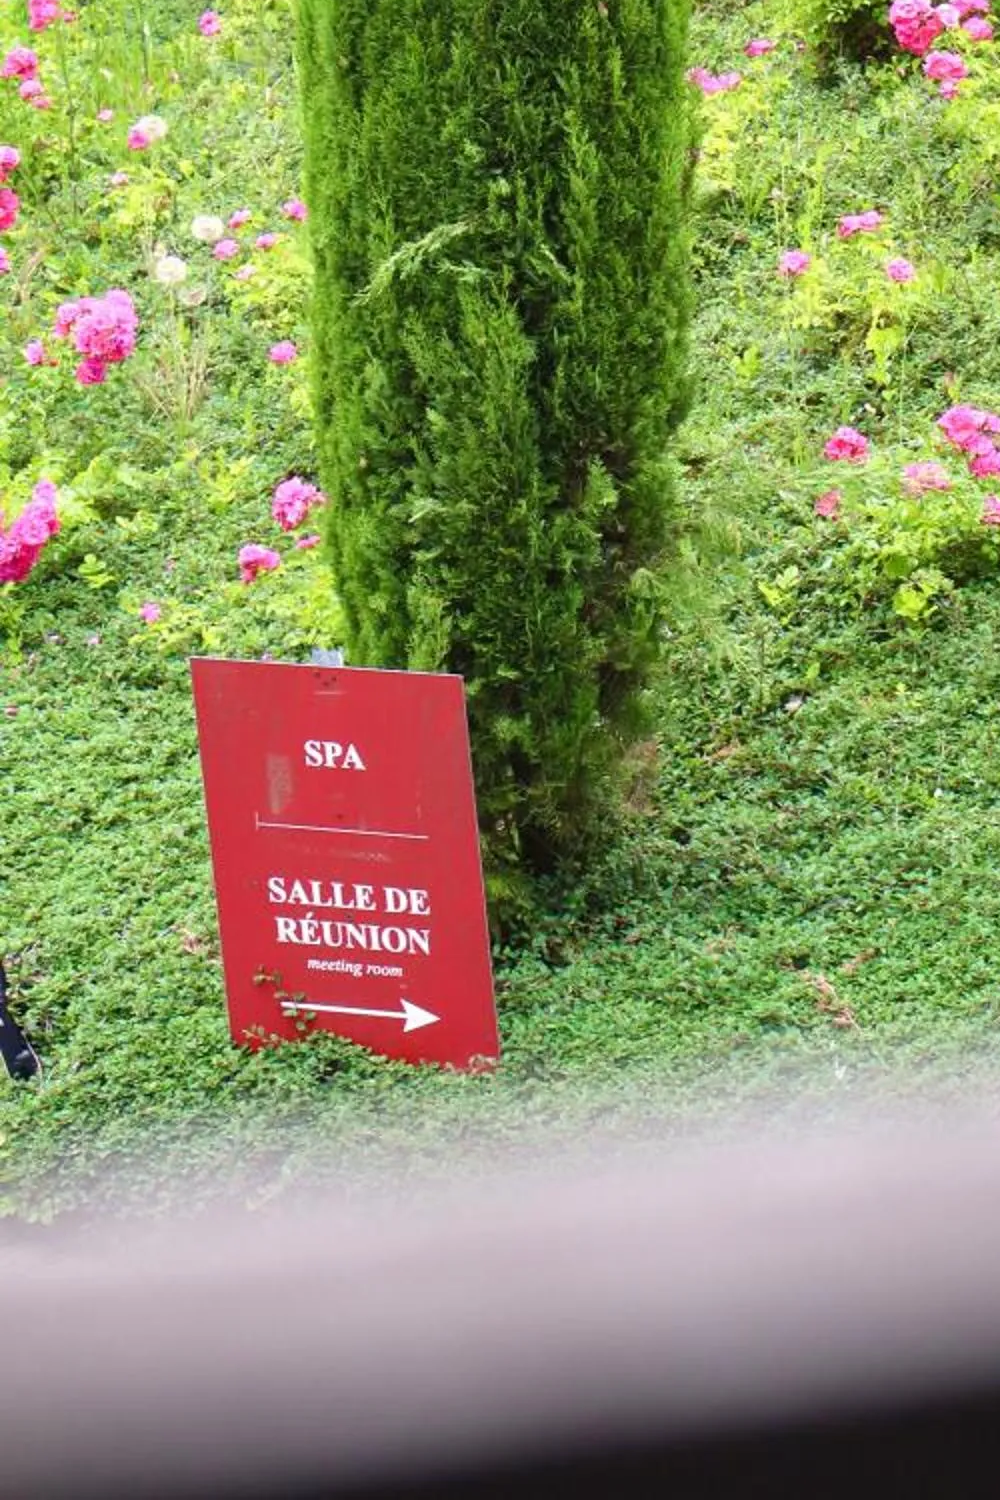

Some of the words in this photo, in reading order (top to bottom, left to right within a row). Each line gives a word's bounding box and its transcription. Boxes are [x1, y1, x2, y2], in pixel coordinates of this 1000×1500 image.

[303, 739, 367, 771] SPA
[267, 876, 376, 911] SALLE
[383, 886, 431, 915] DE
[274, 911, 431, 955] RÉUNION
[307, 958, 363, 977] meeting
[366, 964, 404, 977] room
